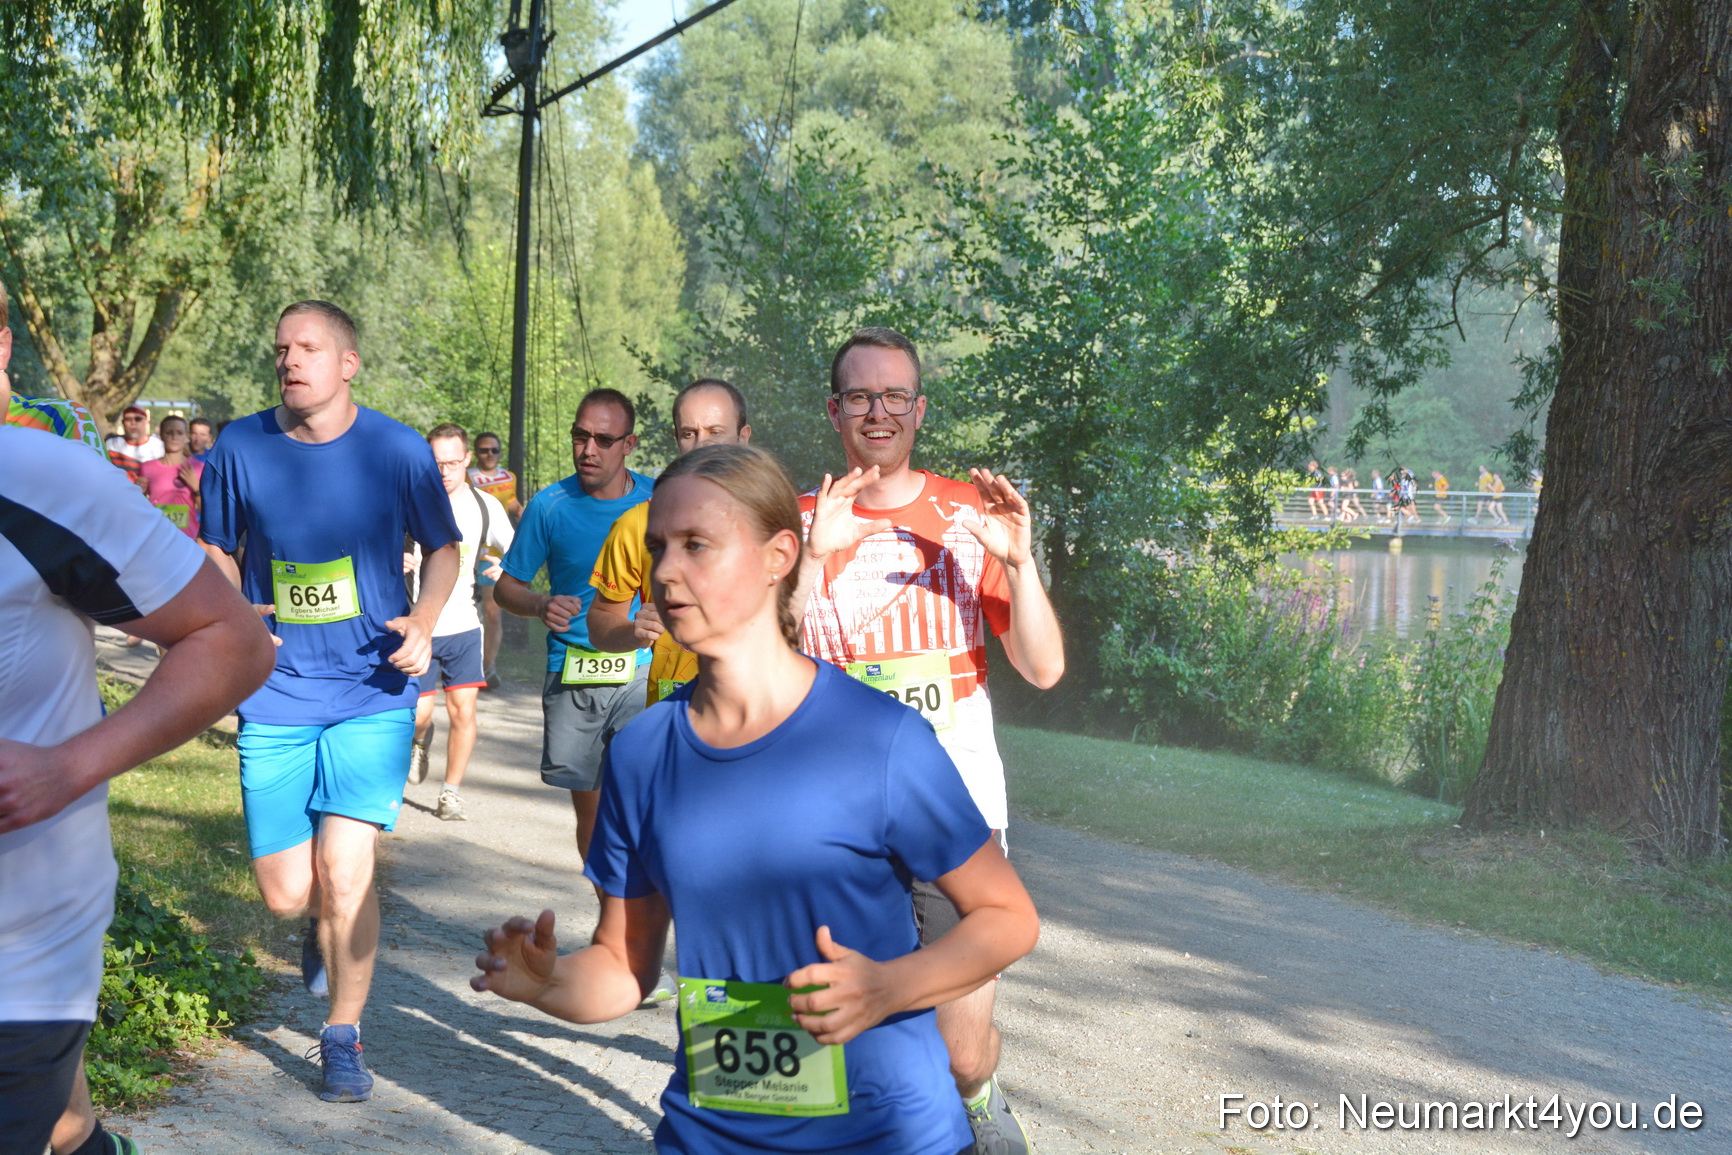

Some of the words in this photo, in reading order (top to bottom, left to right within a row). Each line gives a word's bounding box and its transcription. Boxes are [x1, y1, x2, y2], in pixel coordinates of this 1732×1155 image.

[289, 584, 338, 607] 664
[290, 607, 313, 615] Egbers
[314, 605, 340, 613] Michael
[574, 657, 626, 674] 1399
[714, 1028, 801, 1077] 658
[714, 1074, 759, 1091] Stepper
[762, 1080, 809, 1093] Melanie
[744, 1091, 770, 1102] Berger
